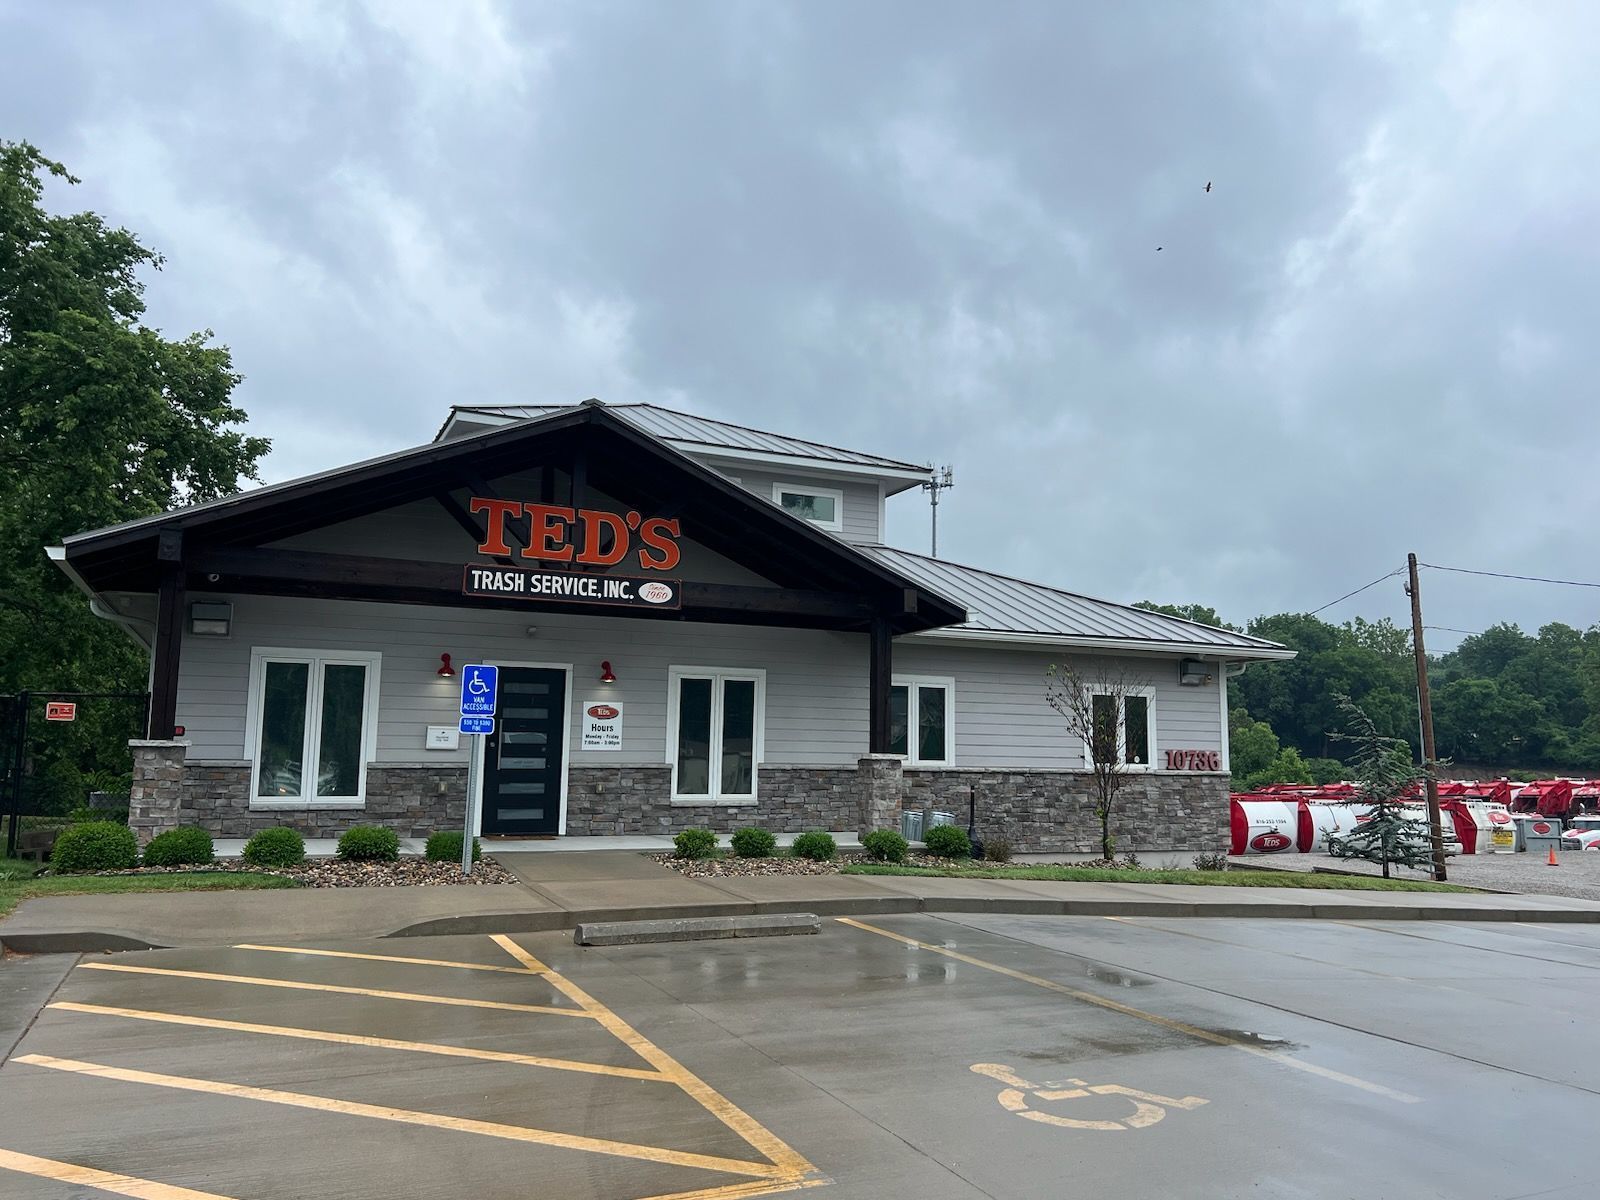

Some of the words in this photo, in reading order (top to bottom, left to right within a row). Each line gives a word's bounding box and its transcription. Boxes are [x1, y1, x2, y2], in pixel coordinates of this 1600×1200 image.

[470, 497, 681, 570] TED'S
[472, 570, 524, 592] TRASH
[646, 590, 668, 600] 1960
[463, 703, 493, 711] ACCESSIBLE
[591, 723, 614, 732] Hours
[1165, 749, 1220, 771] 10736
